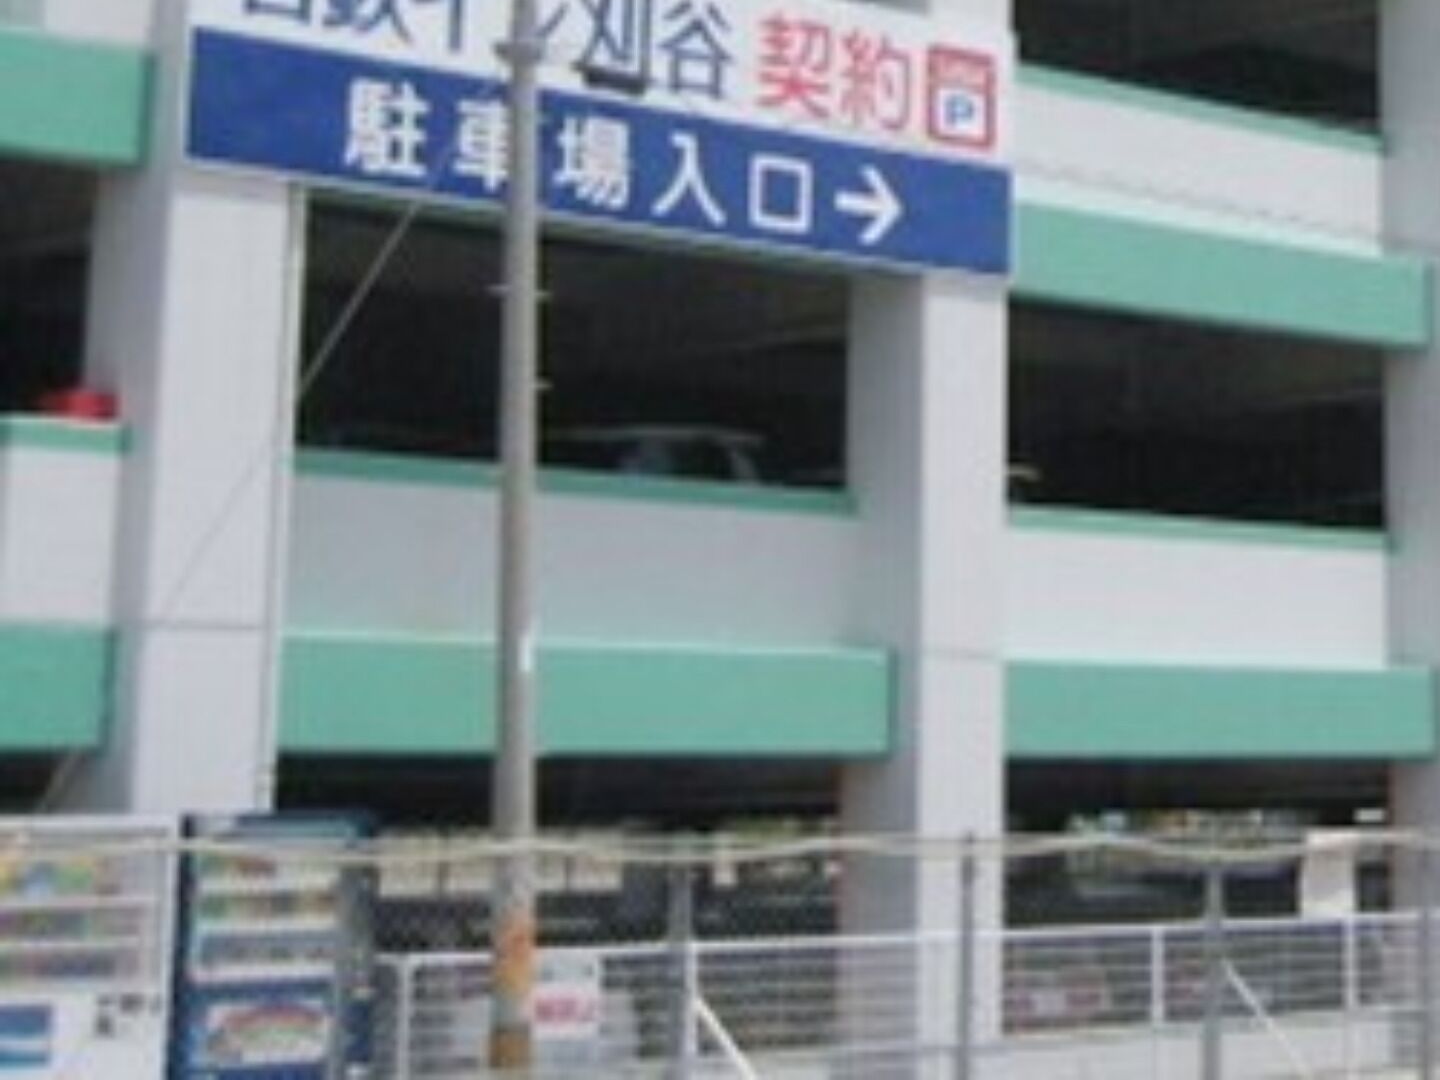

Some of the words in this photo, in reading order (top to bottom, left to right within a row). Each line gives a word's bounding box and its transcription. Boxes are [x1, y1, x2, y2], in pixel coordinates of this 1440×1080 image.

[756, 11, 913, 132] 契約
[944, 94, 975, 128] P
[343, 77, 813, 234] 駐車場入口
